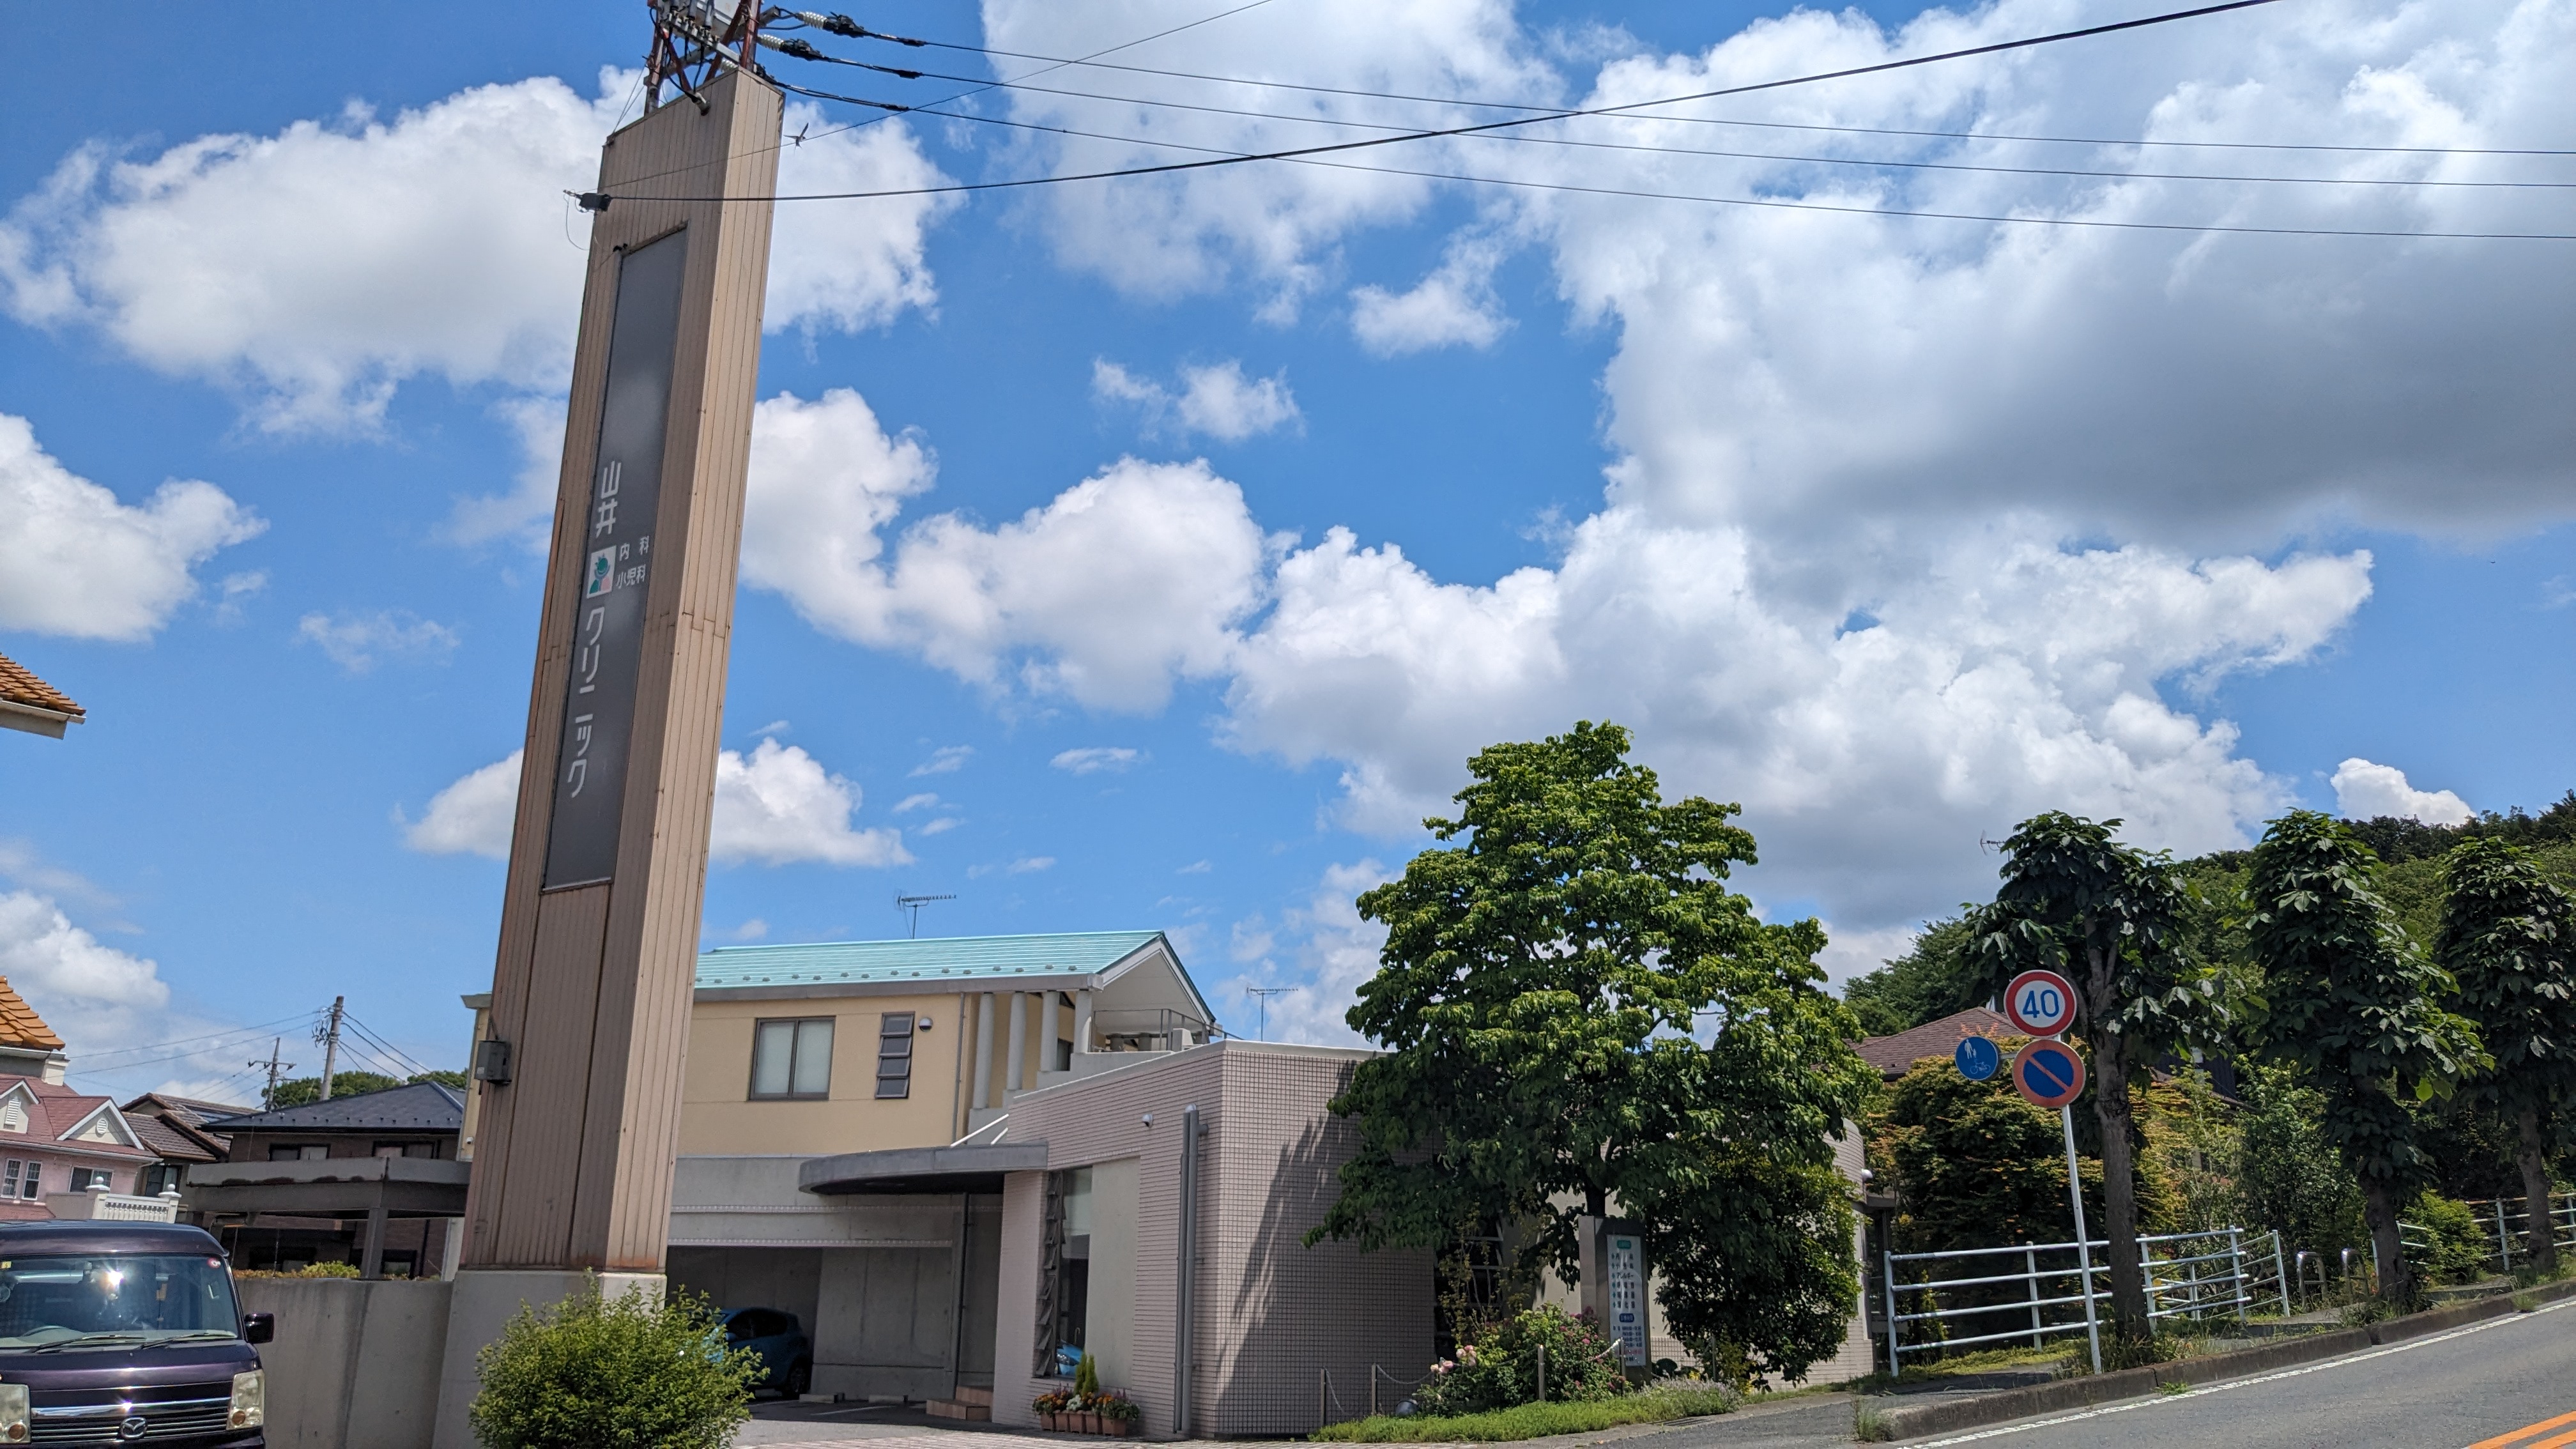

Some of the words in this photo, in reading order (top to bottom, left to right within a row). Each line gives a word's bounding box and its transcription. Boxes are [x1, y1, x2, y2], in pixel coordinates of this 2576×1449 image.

[596, 461, 622, 536] 山井
[619, 535, 649, 562] 内科
[616, 564, 646, 589] 小児科
[567, 607, 605, 797] クリニック
[2023, 990, 2059, 1018] 40
